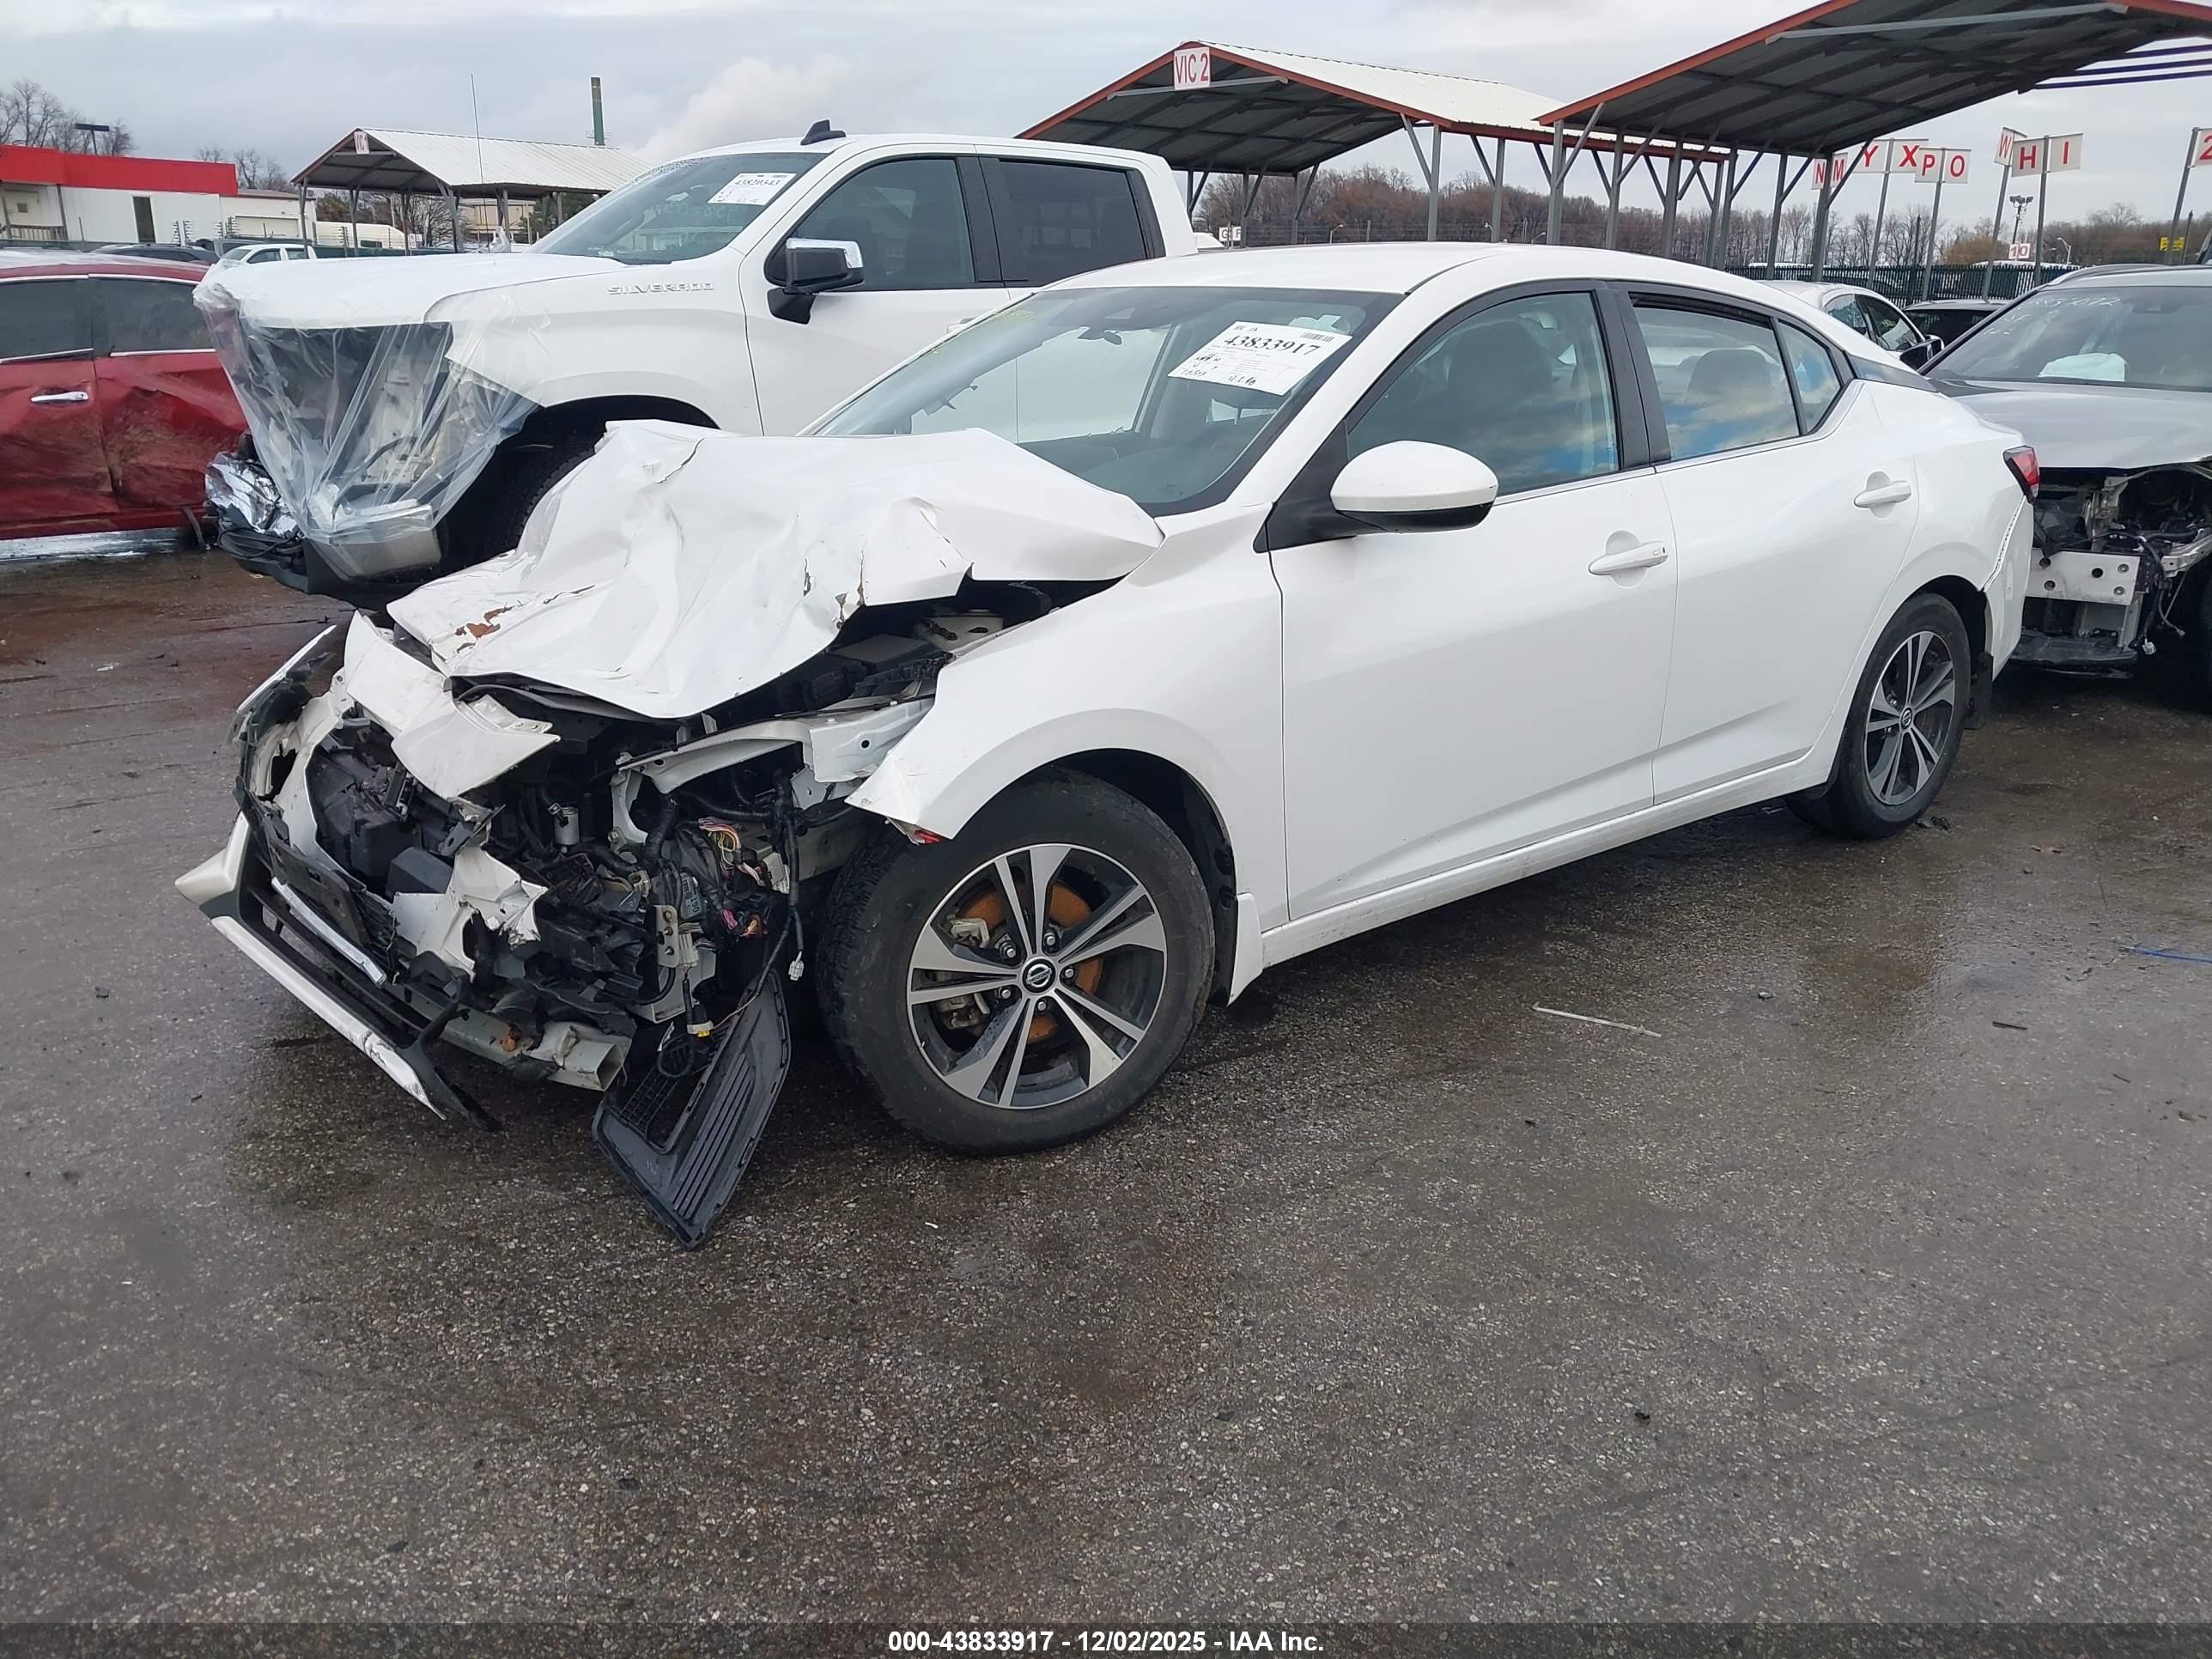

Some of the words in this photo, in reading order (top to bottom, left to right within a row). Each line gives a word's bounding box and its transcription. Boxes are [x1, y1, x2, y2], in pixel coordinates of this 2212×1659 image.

[1175, 53, 1197, 84] VIC
[1200, 52, 1209, 82] 2
[1861, 145, 1880, 167] Y
[1899, 144, 1920, 167] X
[1998, 134, 2012, 159] W
[2019, 144, 2037, 170] H
[2063, 141, 2070, 165] I
[1815, 162, 1826, 185] N
[1832, 158, 1845, 182] M
[1922, 154, 1936, 177] P
[1950, 155, 1966, 178] O
[2010, 246, 2029, 257] 10
[608, 282, 714, 295] SILVERADO
[1224, 335, 1322, 356] 43833917
